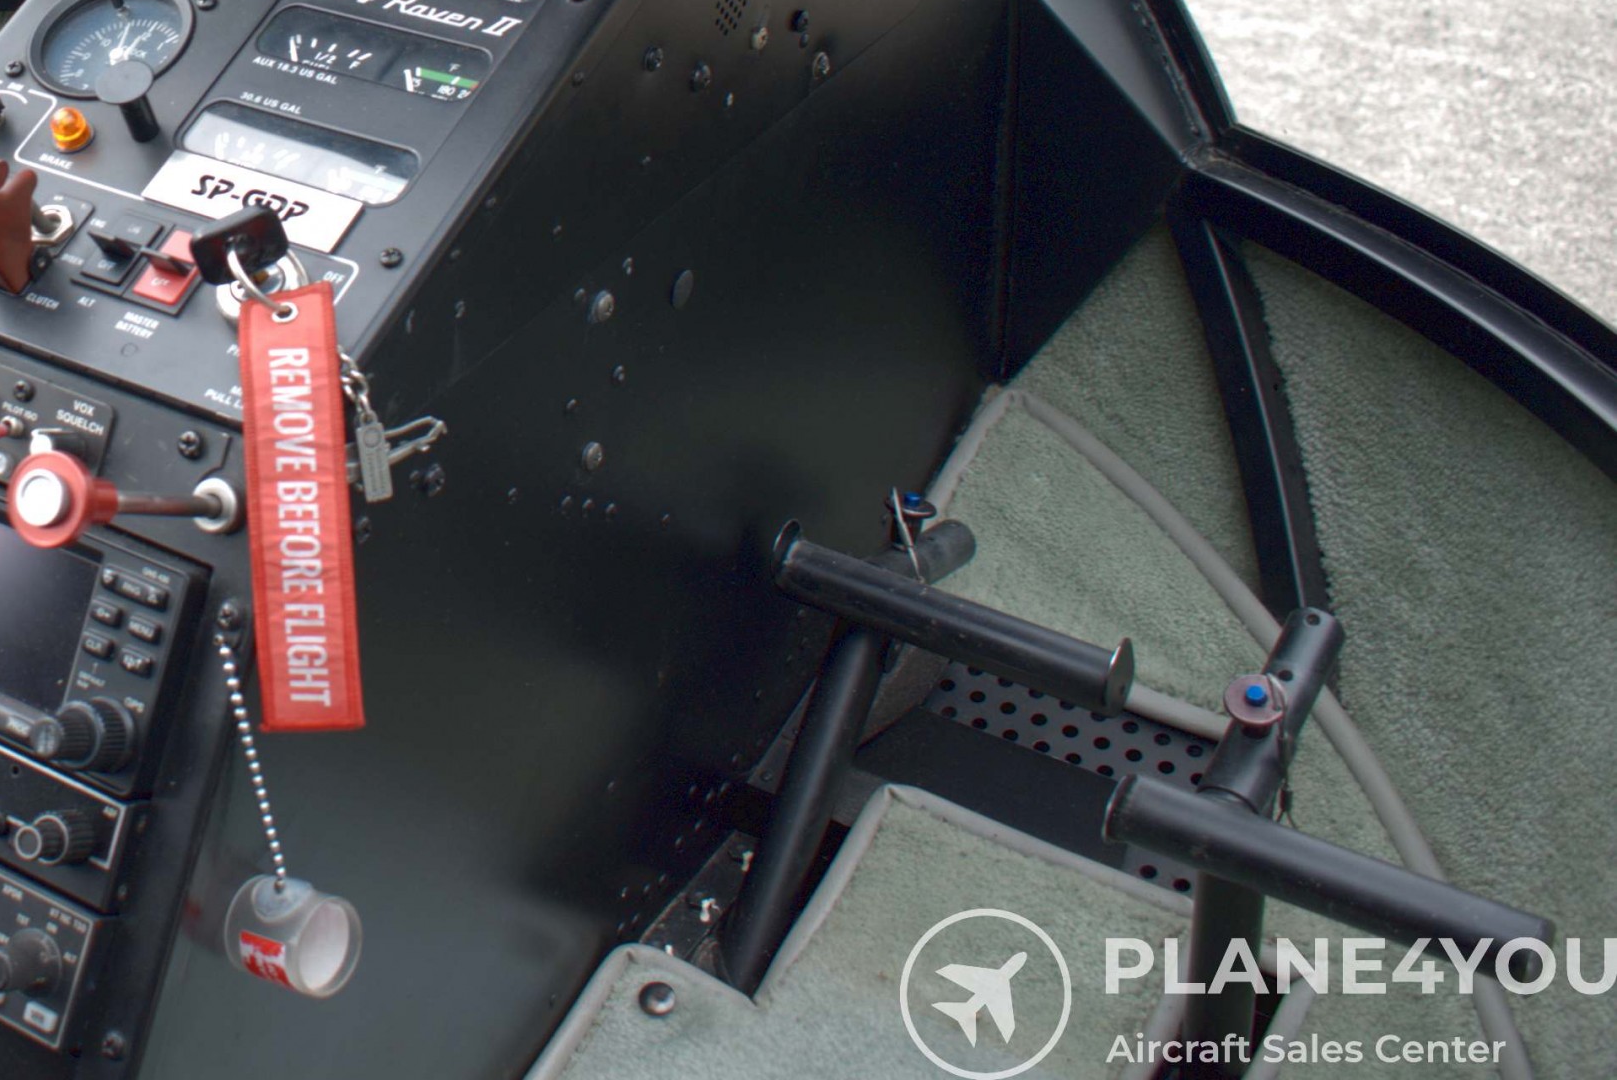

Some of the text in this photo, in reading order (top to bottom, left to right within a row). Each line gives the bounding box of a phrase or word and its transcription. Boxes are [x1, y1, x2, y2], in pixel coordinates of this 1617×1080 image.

[482, 16, 523, 37] II
[253, 56, 276, 68] AUX
[299, 68, 315, 78] US
[315, 73, 338, 85] GAL
[263, 96, 279, 108] US
[279, 101, 303, 115] GAL
[38, 153, 74, 170] BRAKE
[191, 174, 310, 222] SP-GDP
[322, 270, 345, 285] OFF
[25, 292, 60, 310] CLUTCH
[77, 295, 97, 308] ALT
[114, 320, 154, 339] BATTERY
[123, 311, 160, 330] MASTER
[2, 401, 25, 416] PILOT
[73, 399, 96, 417] VOX
[56, 408, 104, 436] SQUELCH
[268, 346, 332, 708] REMOVE BEFORE FLIGHT
